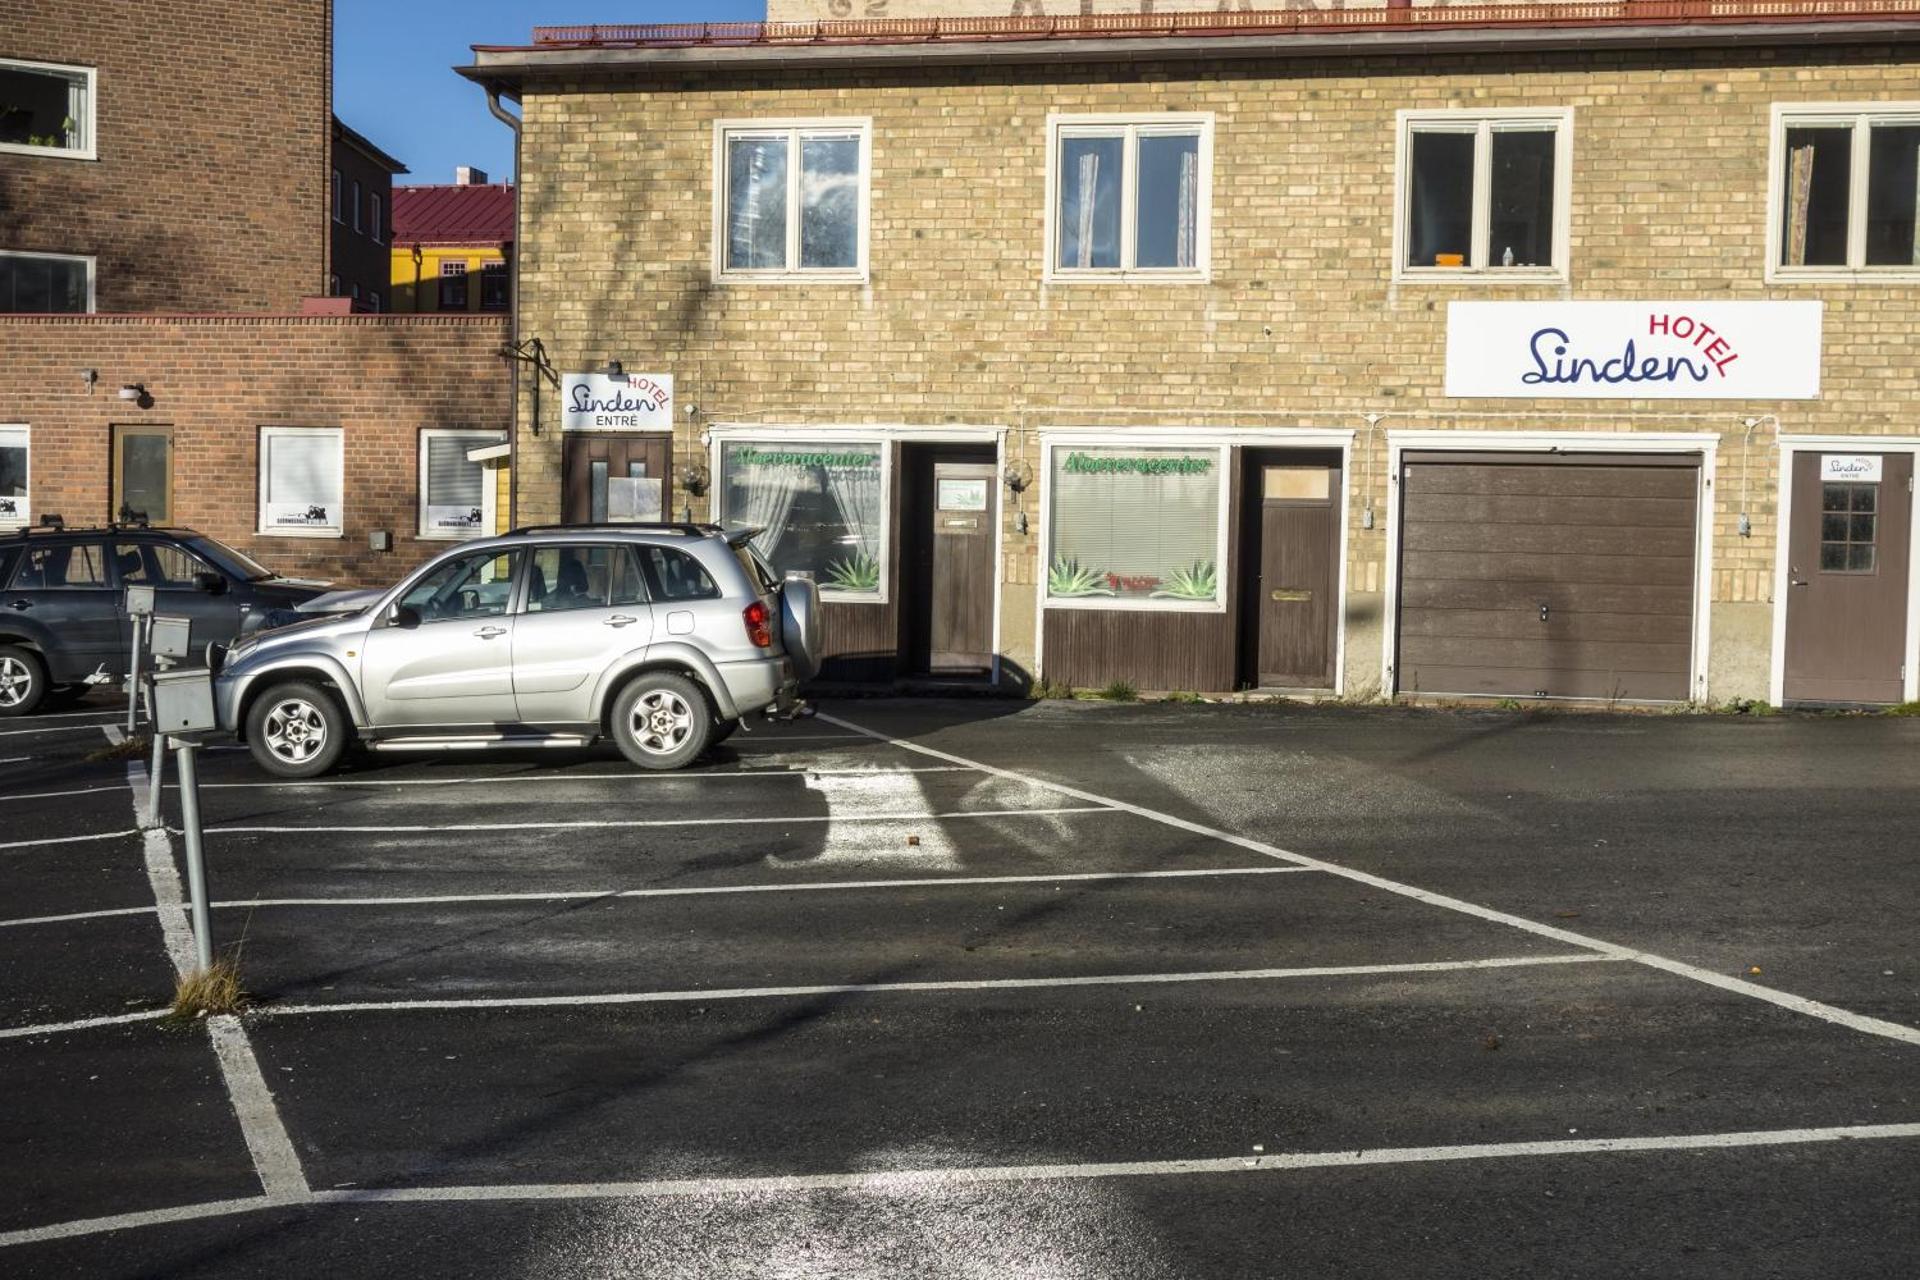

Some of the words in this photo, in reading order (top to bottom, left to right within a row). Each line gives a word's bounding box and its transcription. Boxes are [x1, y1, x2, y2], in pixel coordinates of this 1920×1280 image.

[1521, 327, 1709, 385] Sinden
[1649, 314, 1739, 378] HOTEL
[568, 383, 656, 413] Sinden
[627, 377, 670, 410] HOTEL
